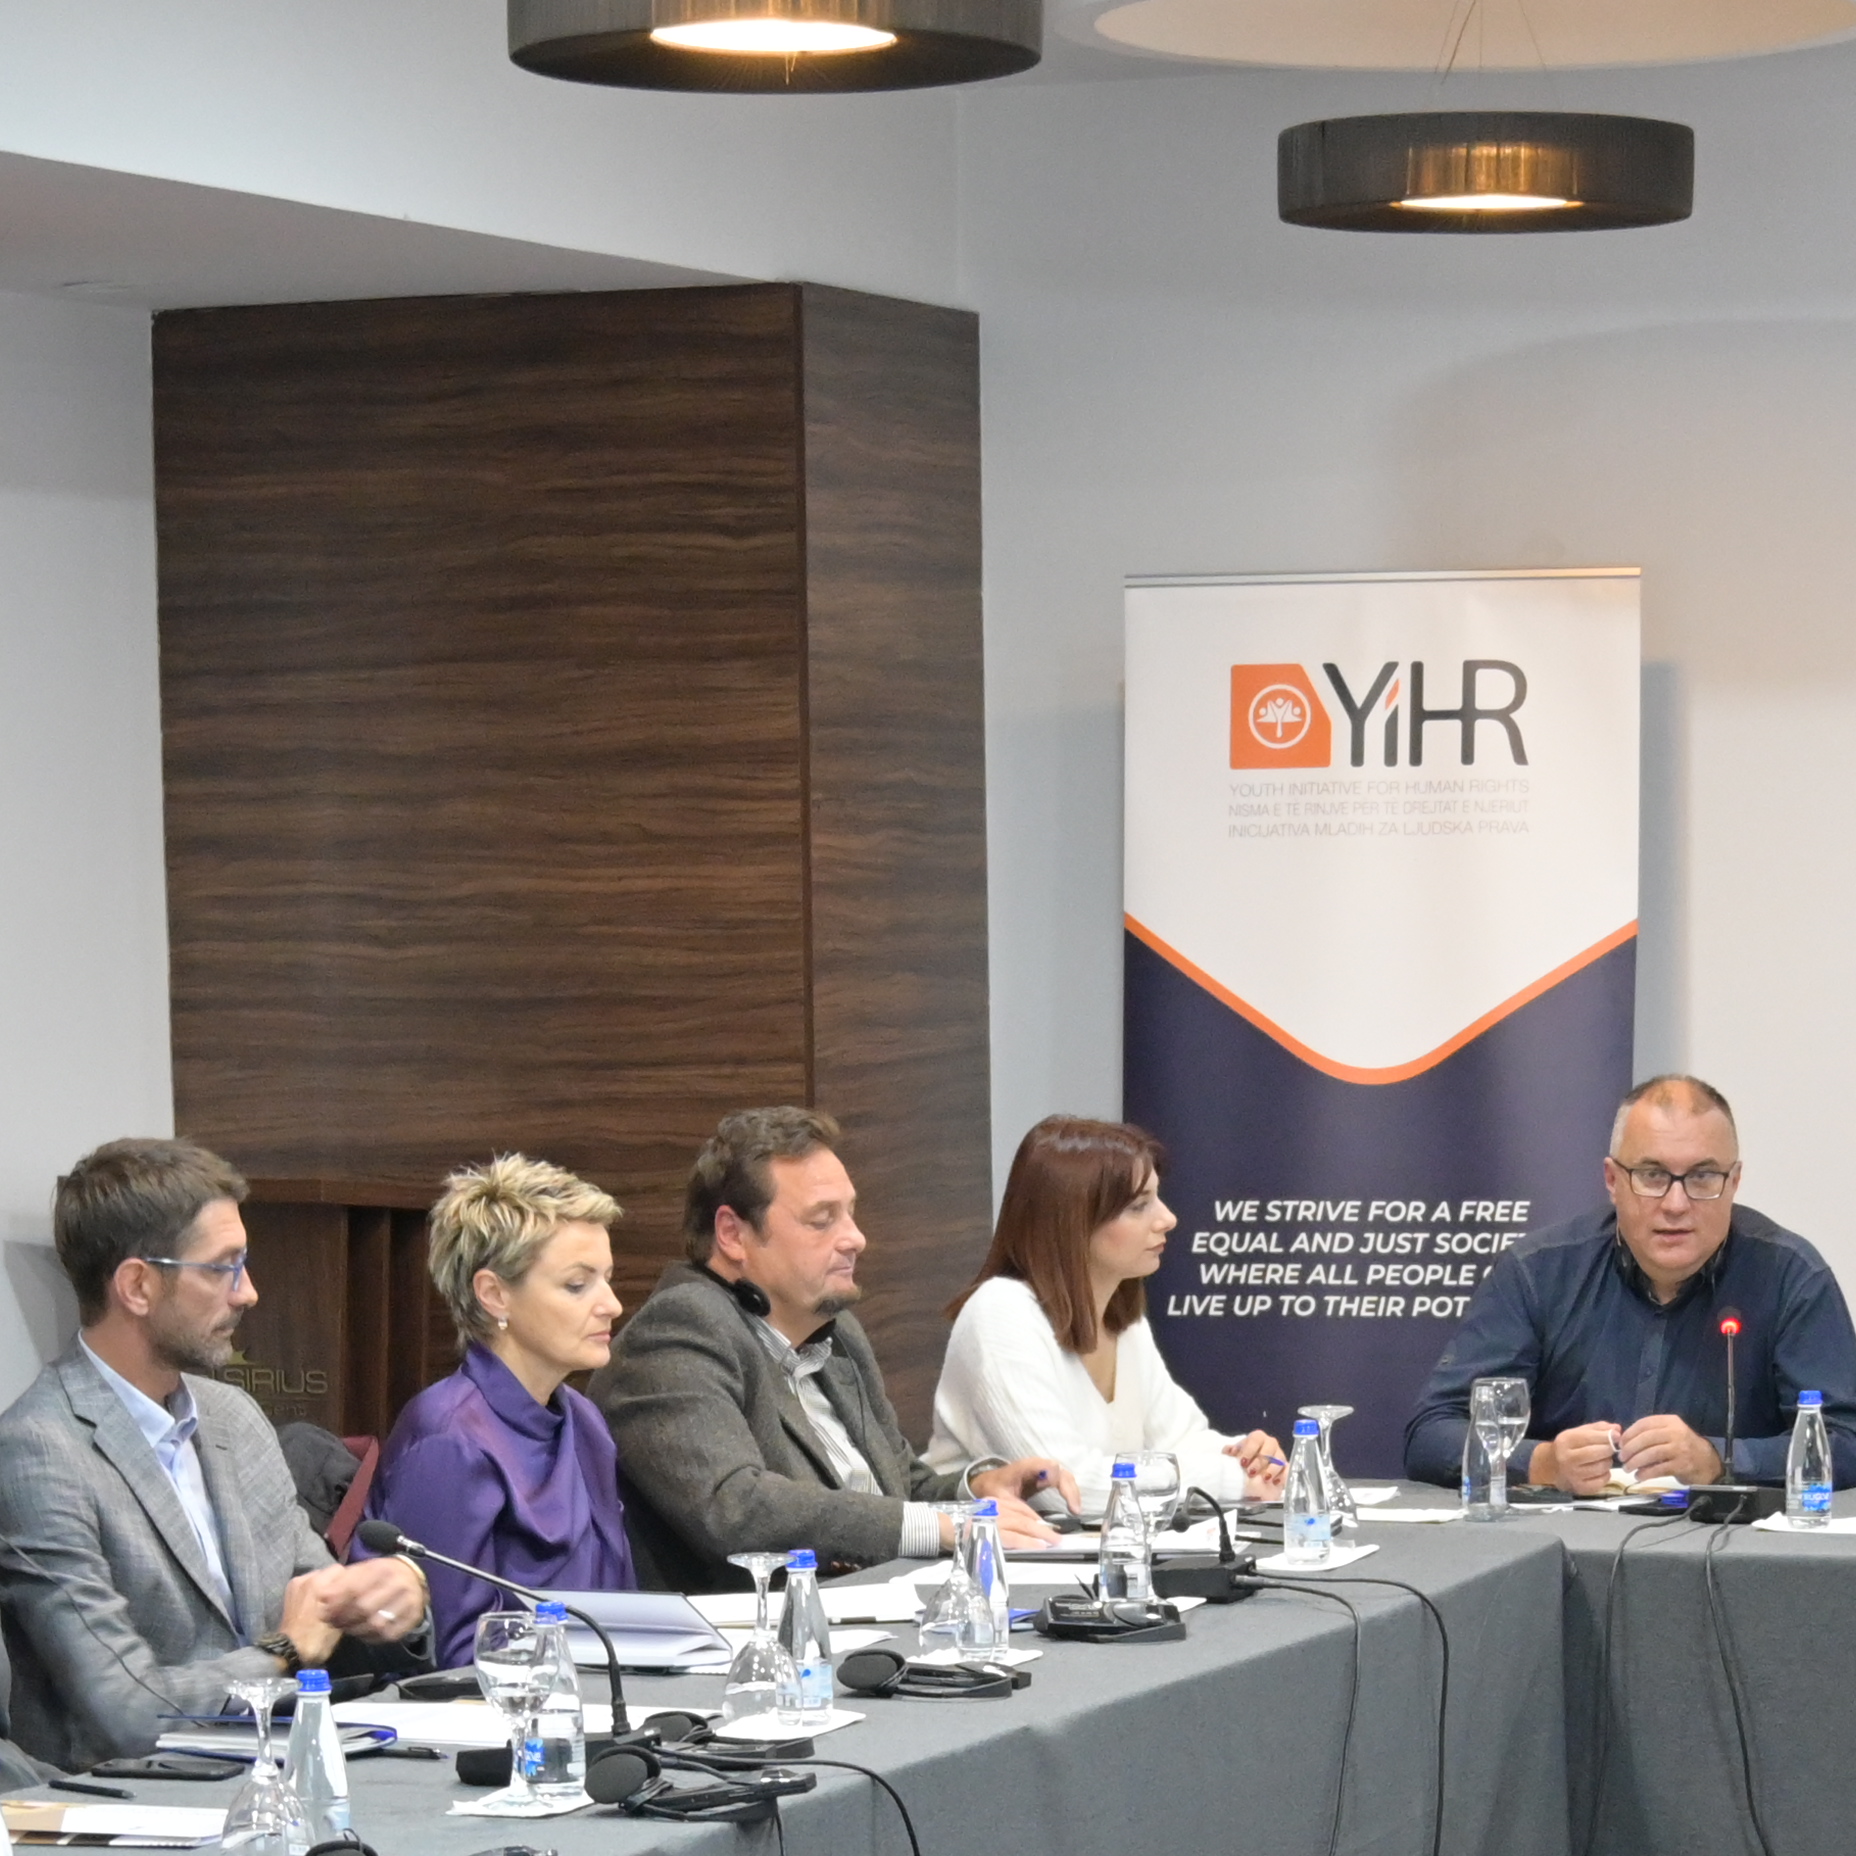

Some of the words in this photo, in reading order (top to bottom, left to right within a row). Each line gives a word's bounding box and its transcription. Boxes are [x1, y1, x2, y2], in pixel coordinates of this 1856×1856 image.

[1229, 782, 1284, 798] YOUTH
[1288, 780, 1363, 797] INITIATIVE
[1367, 780, 1401, 796] FOR
[1404, 779, 1465, 796] HUMAN
[1469, 778, 1530, 795] RIGHTS
[1228, 803, 1270, 818] NISMA
[1228, 822, 1311, 838] INICIJATIVA
[1314, 821, 1374, 837] MLADIH
[1378, 821, 1398, 837] ZA
[1402, 820, 1473, 836] LJUDSKA
[1477, 819, 1530, 835] PRAVA
[1214, 1200, 1260, 1222] WE
[1265, 1200, 1362, 1222] STRIVE
[1367, 1200, 1426, 1222] FOR
[1430, 1200, 1451, 1222] A
[1459, 1200, 1531, 1222] FREE
[1191, 1231, 1284, 1257] EQUAL
[1289, 1232, 1355, 1254] AND
[1359, 1232, 1430, 1254] JUST
[1433, 1232, 1526, 1254] SOCIE
[1200, 1263, 1302, 1285] WHERE
[1306, 1263, 1359, 1285] ALL
[1366, 1264, 1477, 1286] PEOPLE
[1167, 1294, 1227, 1316] LIVE
[1233, 1295, 1272, 1316] UP
[1279, 1295, 1316, 1317] TO
[1323, 1295, 1406, 1317] THEIR
[223, 1367, 329, 1394] SIRIUS
